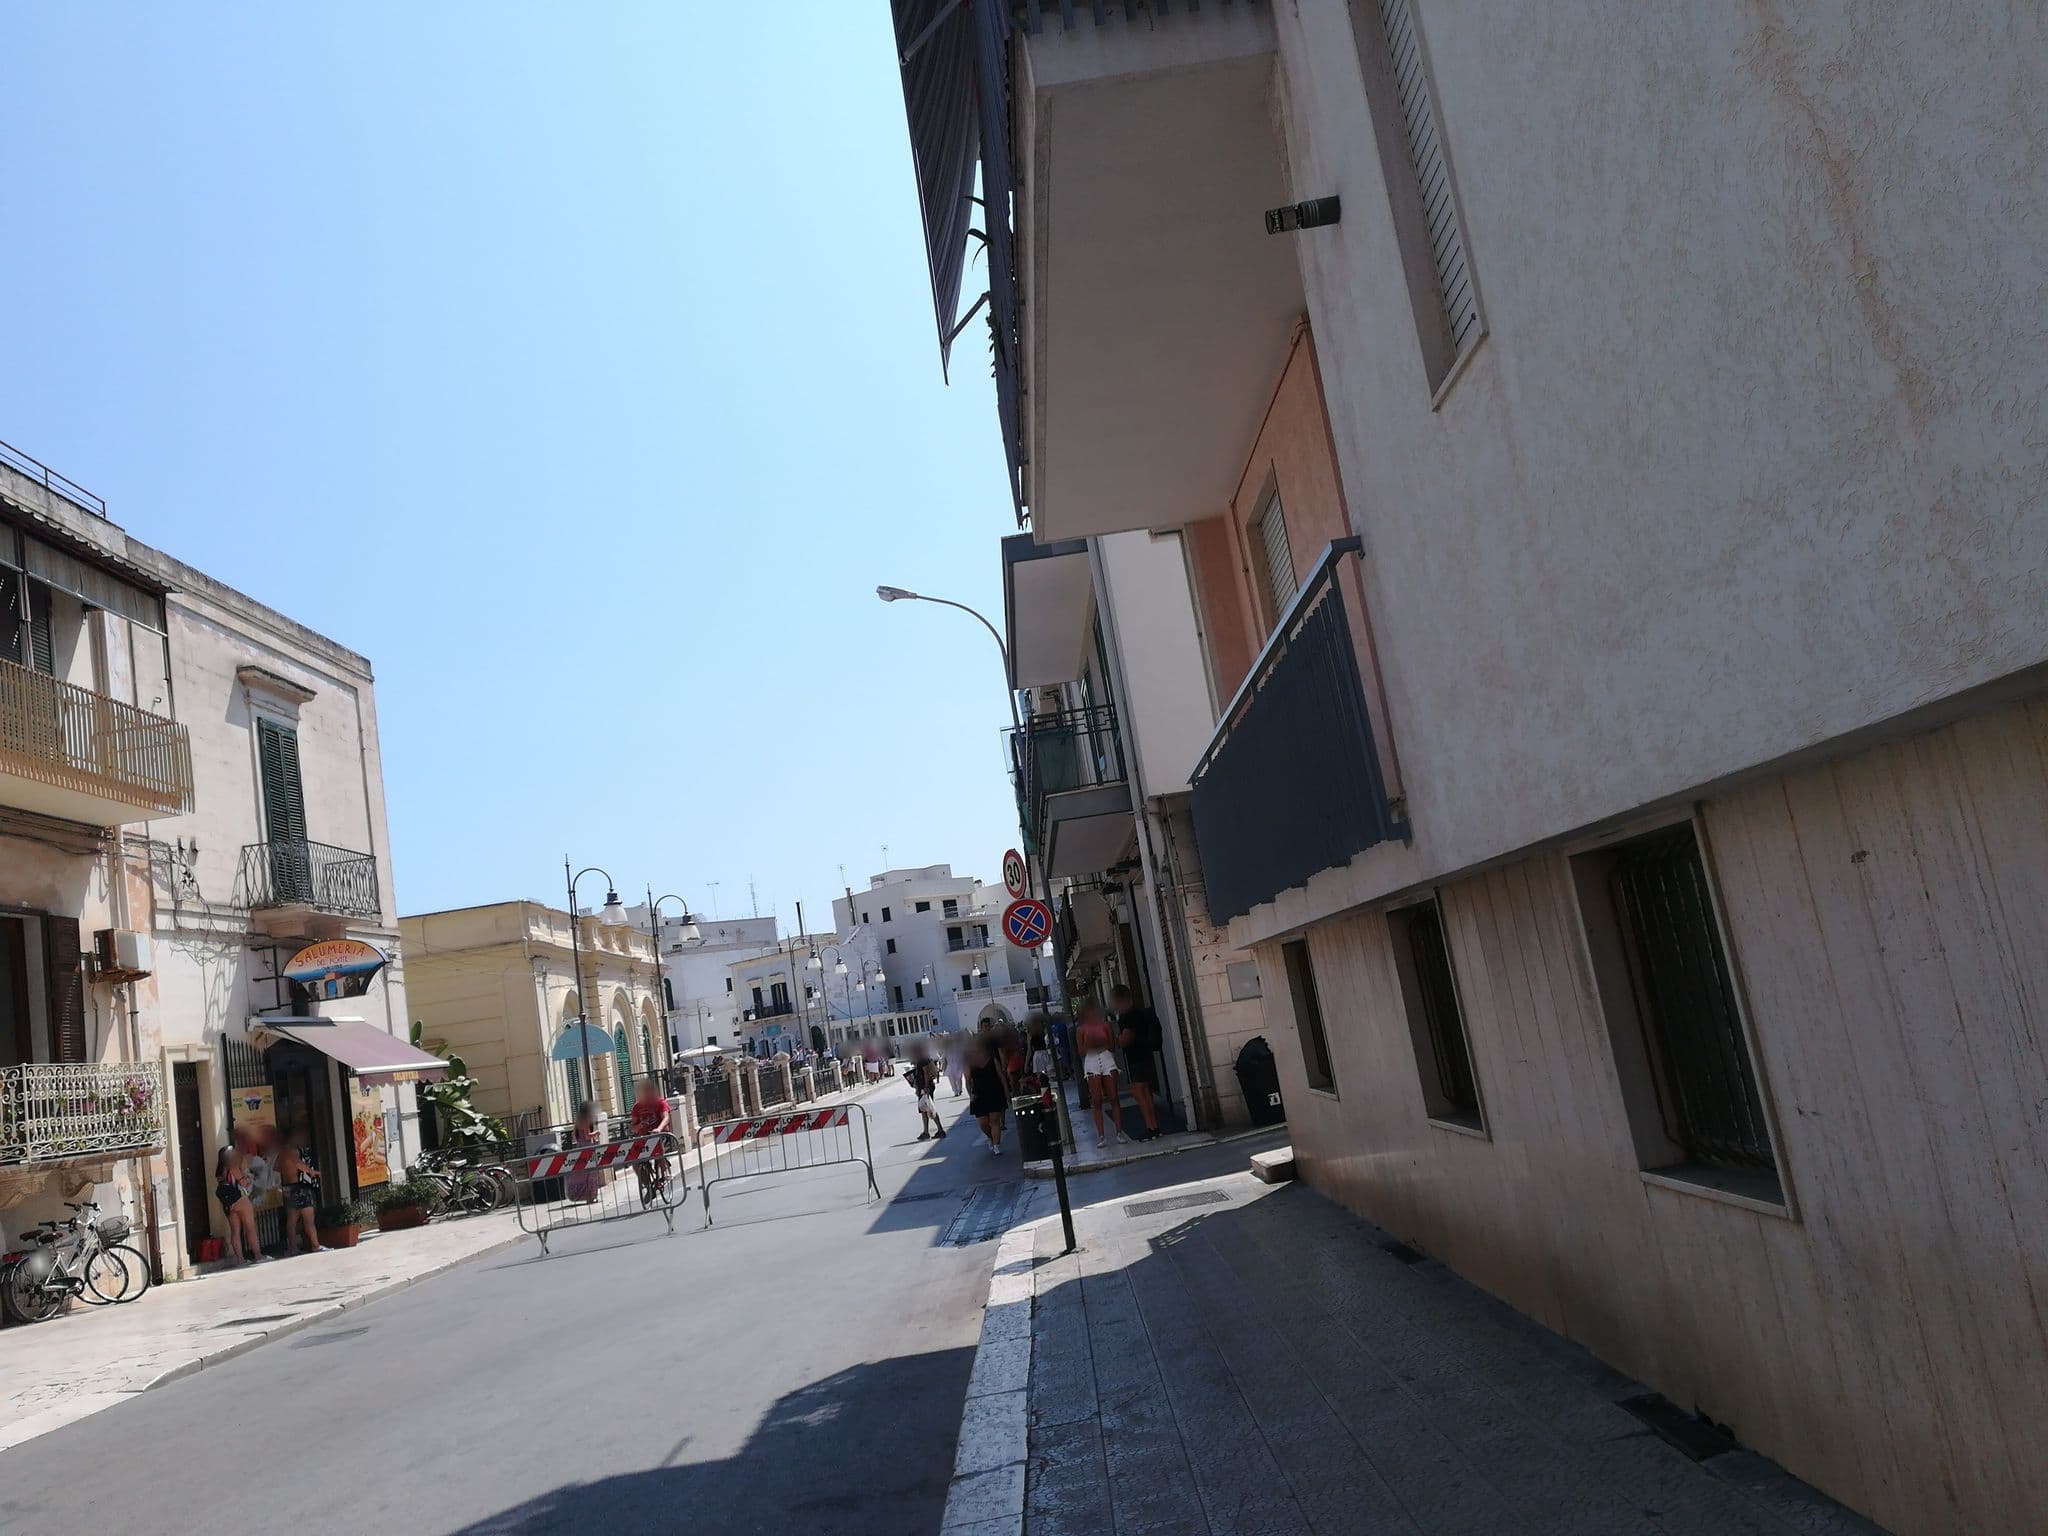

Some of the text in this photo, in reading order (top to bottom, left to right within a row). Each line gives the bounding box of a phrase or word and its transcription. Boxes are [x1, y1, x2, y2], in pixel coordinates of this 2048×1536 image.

[1007, 862, 1020, 886] 30
[295, 943, 365, 967] SALUMERIA
[782, 1114, 812, 1125] LOLE
